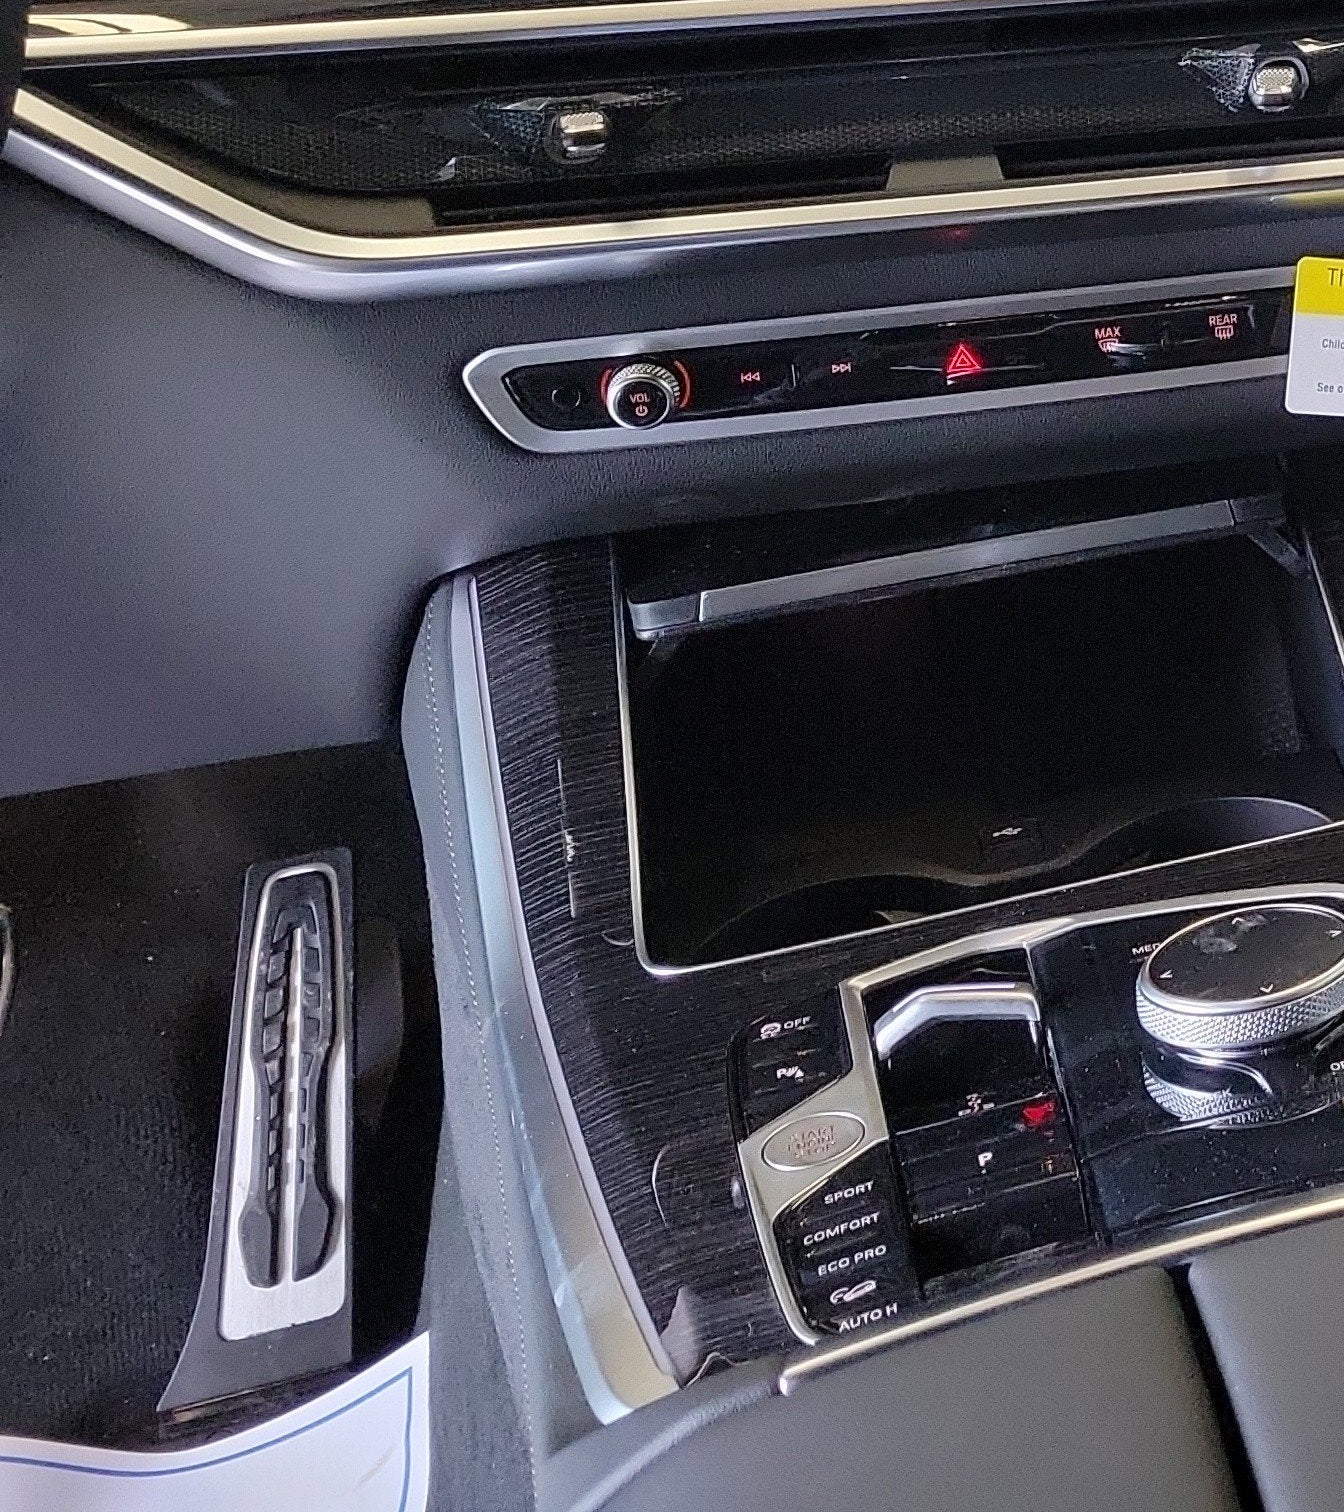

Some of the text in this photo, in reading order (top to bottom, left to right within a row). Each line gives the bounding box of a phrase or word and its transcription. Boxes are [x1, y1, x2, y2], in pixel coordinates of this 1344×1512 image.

[1208, 313, 1238, 327] REAR
[1094, 326, 1121, 340] MAX
[1317, 382, 1334, 393] See
[629, 392, 651, 403] VOL
[783, 1016, 811, 1029] OFF
[977, 1152, 993, 1167] P
[824, 1180, 874, 1204] SPORT
[803, 1212, 880, 1246] COMFORT
[818, 1244, 887, 1276] ECO PRO
[838, 1302, 898, 1334] AUTO H
